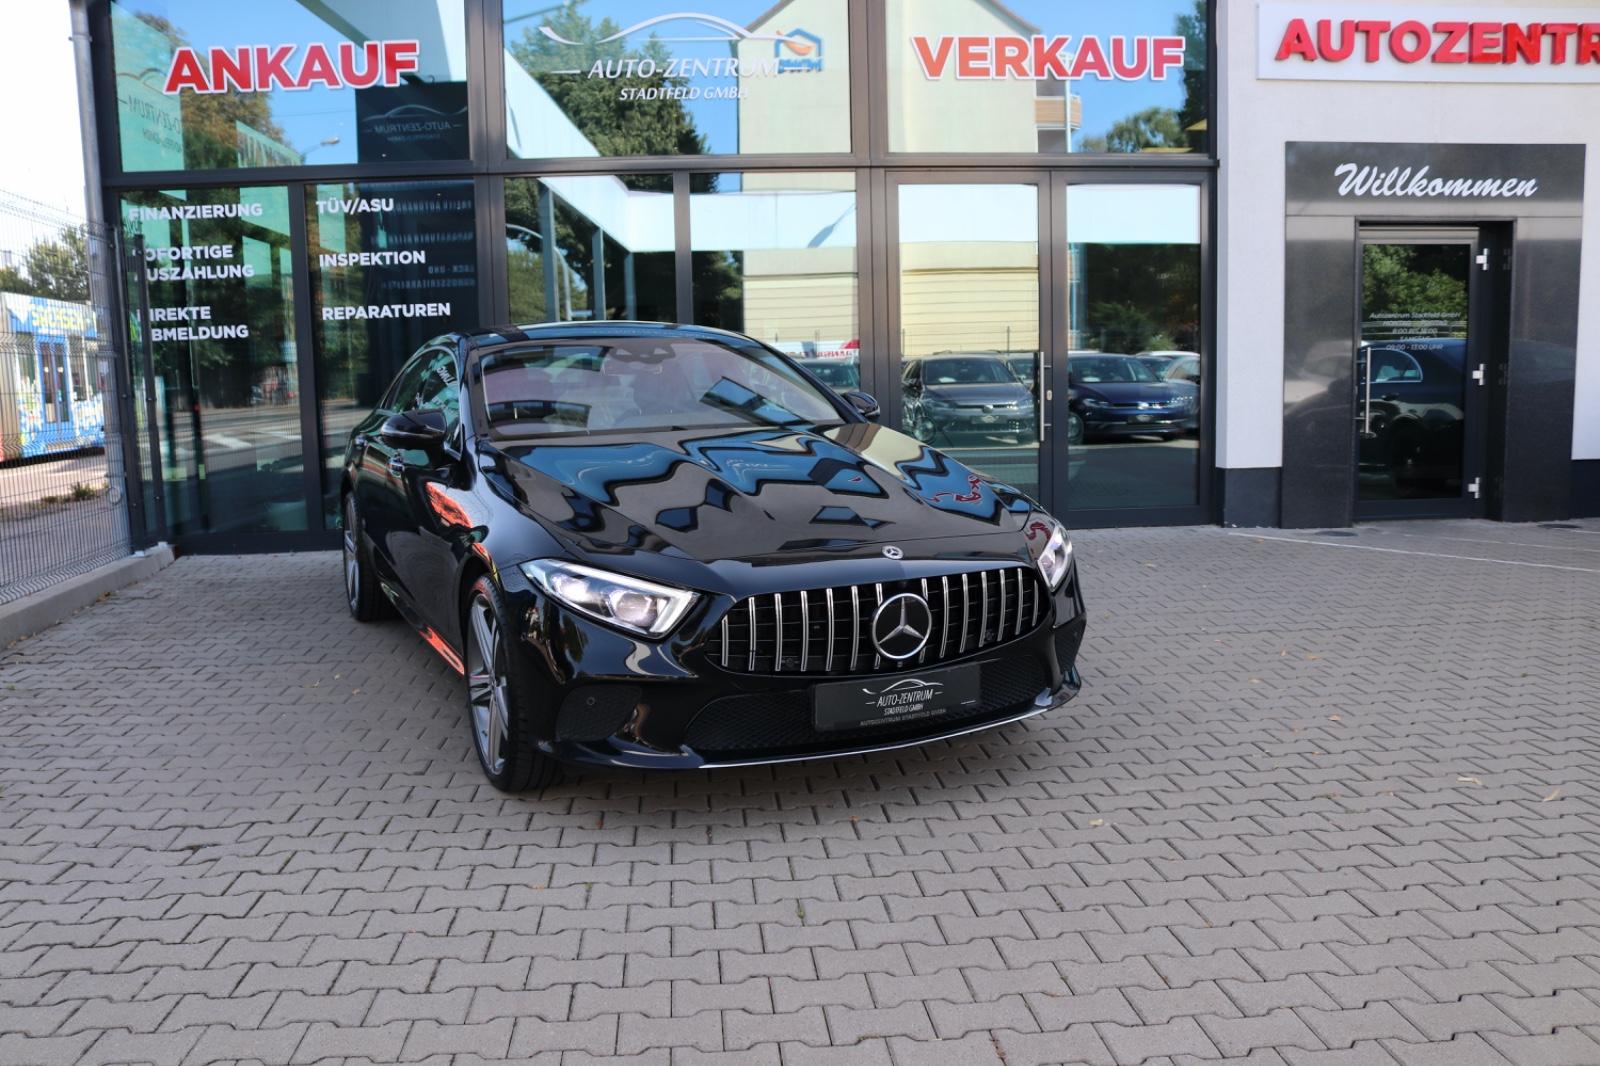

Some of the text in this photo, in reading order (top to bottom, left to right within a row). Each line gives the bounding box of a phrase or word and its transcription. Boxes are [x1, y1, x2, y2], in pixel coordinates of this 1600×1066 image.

[1275, 18, 1600, 66] AUTOZENTR
[164, 40, 420, 94] ANKAUF
[910, 35, 1186, 81] VERKAUF
[588, 58, 780, 80] AUTO-ZENTRUM
[619, 86, 750, 101] STADTFELD GMBH
[1334, 162, 1538, 199] Willkommen
[128, 203, 263, 221] FINANZIERUNG
[316, 196, 395, 216] TÜV/ASU
[319, 250, 426, 268] INSPEKTION
[135, 264, 255, 282] USZAHLUNG
[321, 302, 451, 321] REPARATUREN
[147, 324, 250, 342] BMELDUNG
[878, 689, 934, 708] AUTO-ZENTRUM
